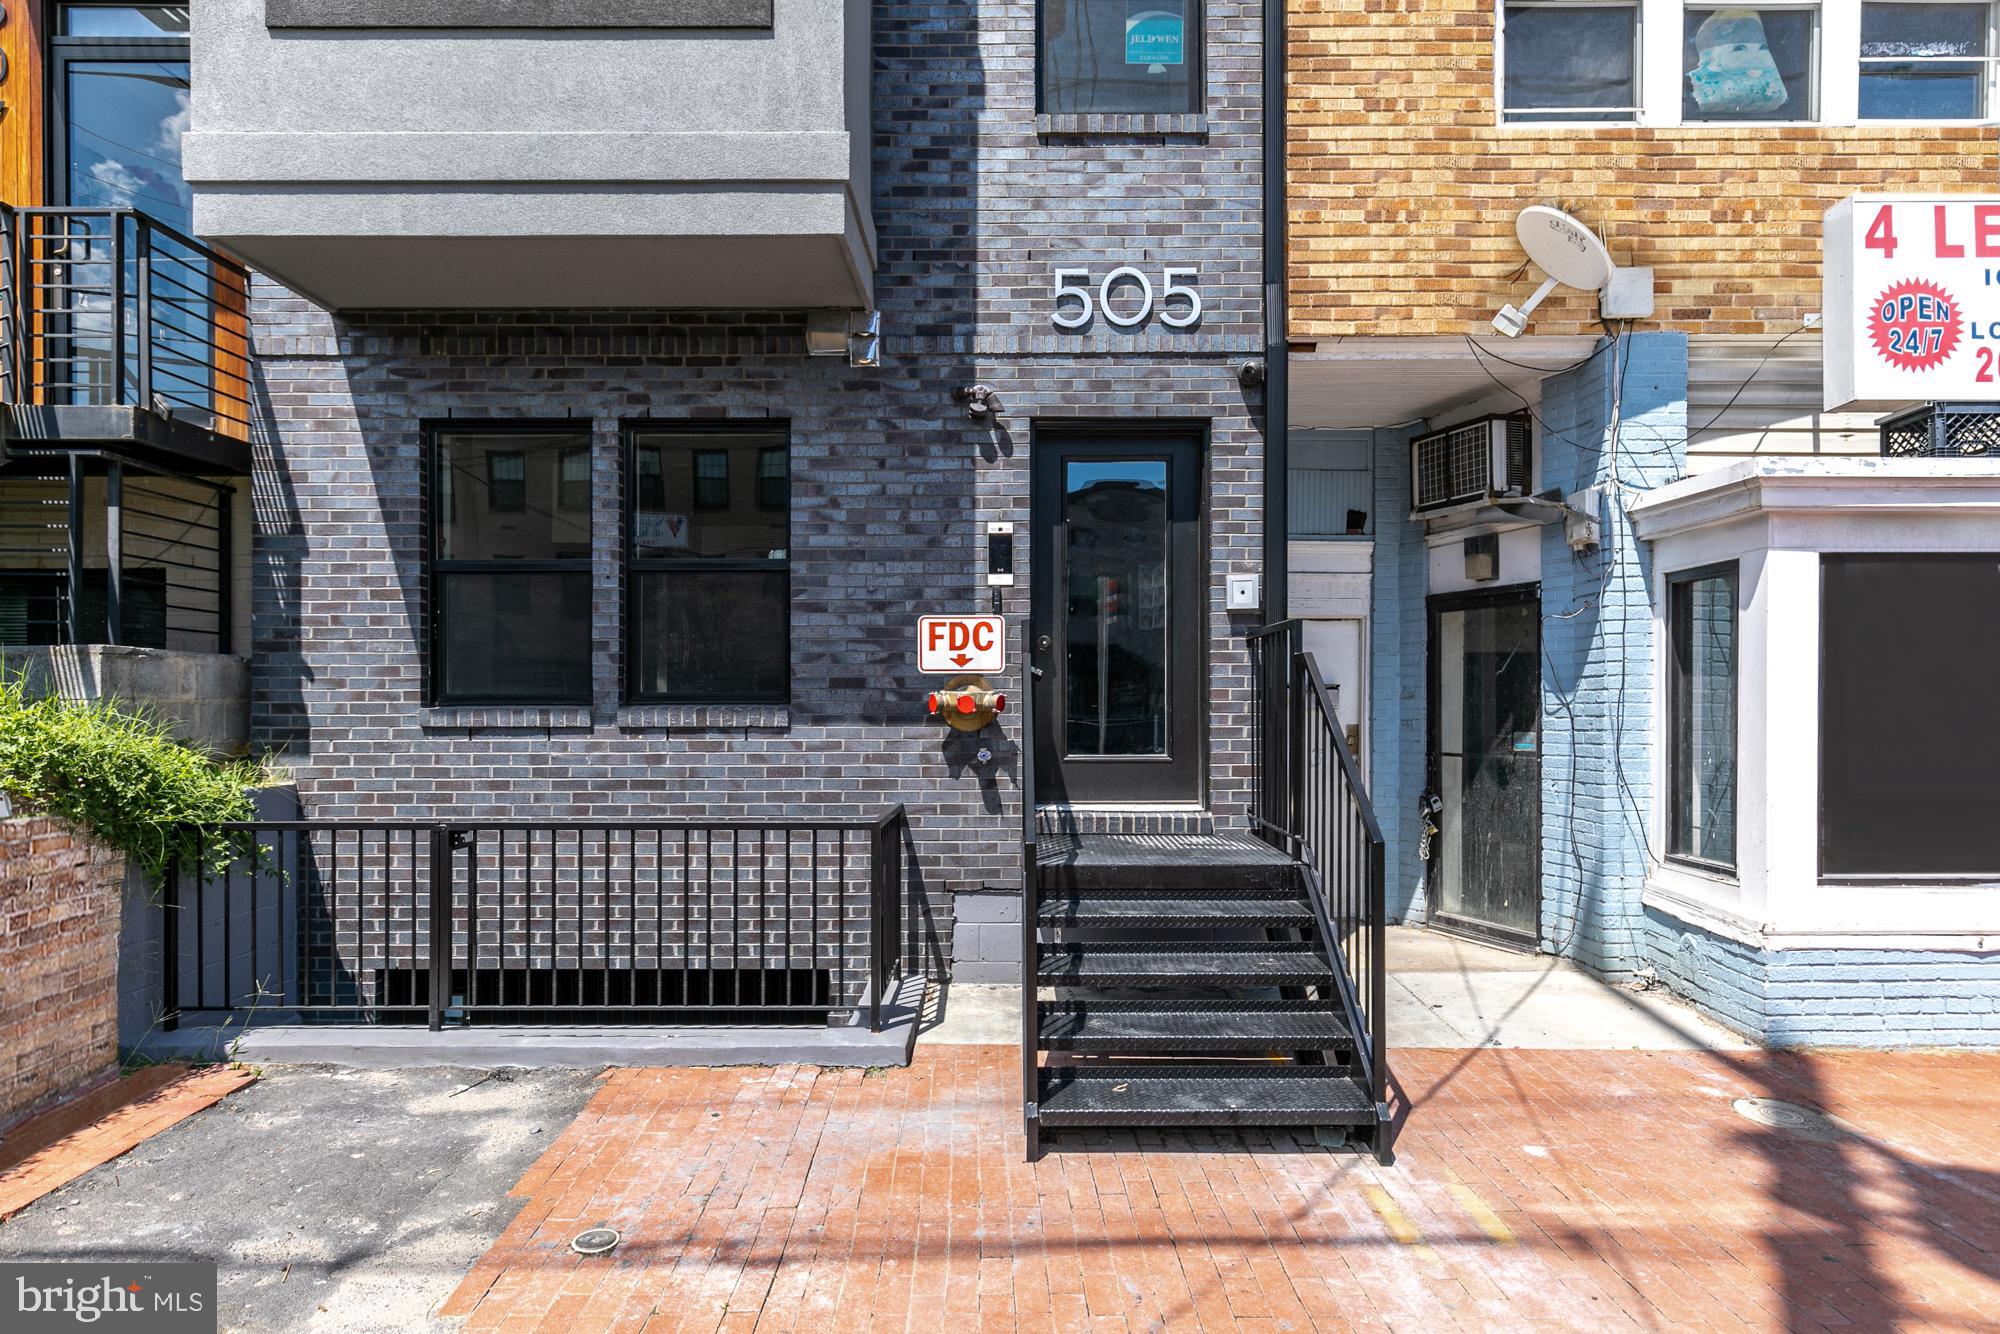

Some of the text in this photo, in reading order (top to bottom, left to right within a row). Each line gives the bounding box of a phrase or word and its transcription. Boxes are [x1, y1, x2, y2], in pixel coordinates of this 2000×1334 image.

[1865, 204, 2000, 258] 4 LE
[1051, 266, 1202, 327] 505
[1882, 295, 1949, 322] OPEN
[1889, 328, 1943, 355] 24/7
[928, 621, 994, 652] FDC
